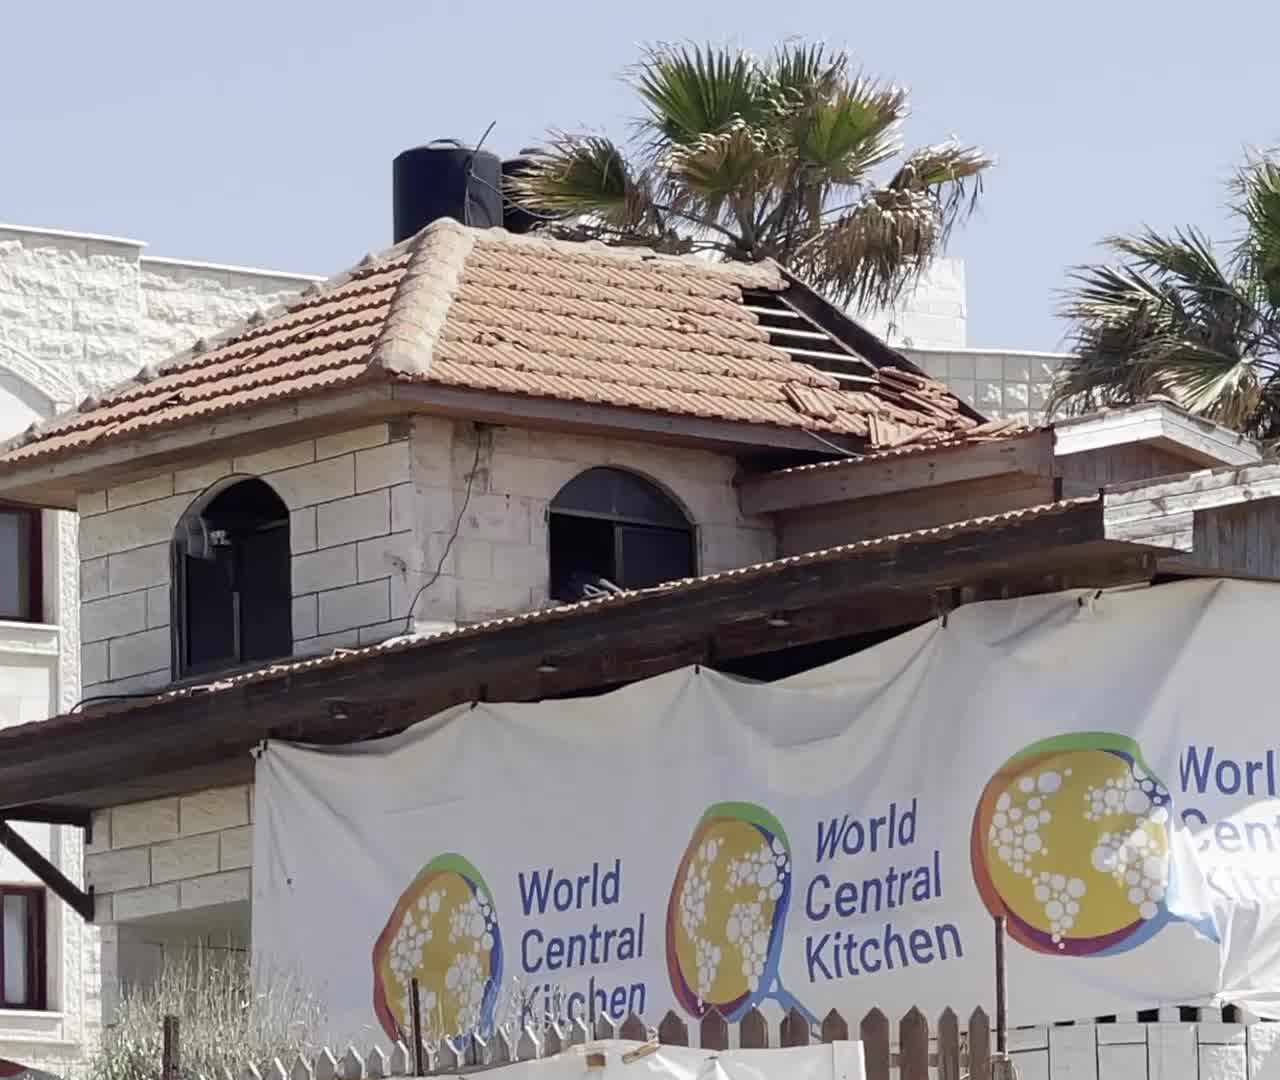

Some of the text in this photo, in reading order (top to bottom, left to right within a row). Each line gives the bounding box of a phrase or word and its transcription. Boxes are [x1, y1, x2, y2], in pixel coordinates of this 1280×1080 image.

[816, 797, 917, 863] World
[518, 858, 621, 916] World
[806, 849, 941, 921] Central
[521, 912, 645, 973] Central
[805, 923, 963, 983] Kitchen
